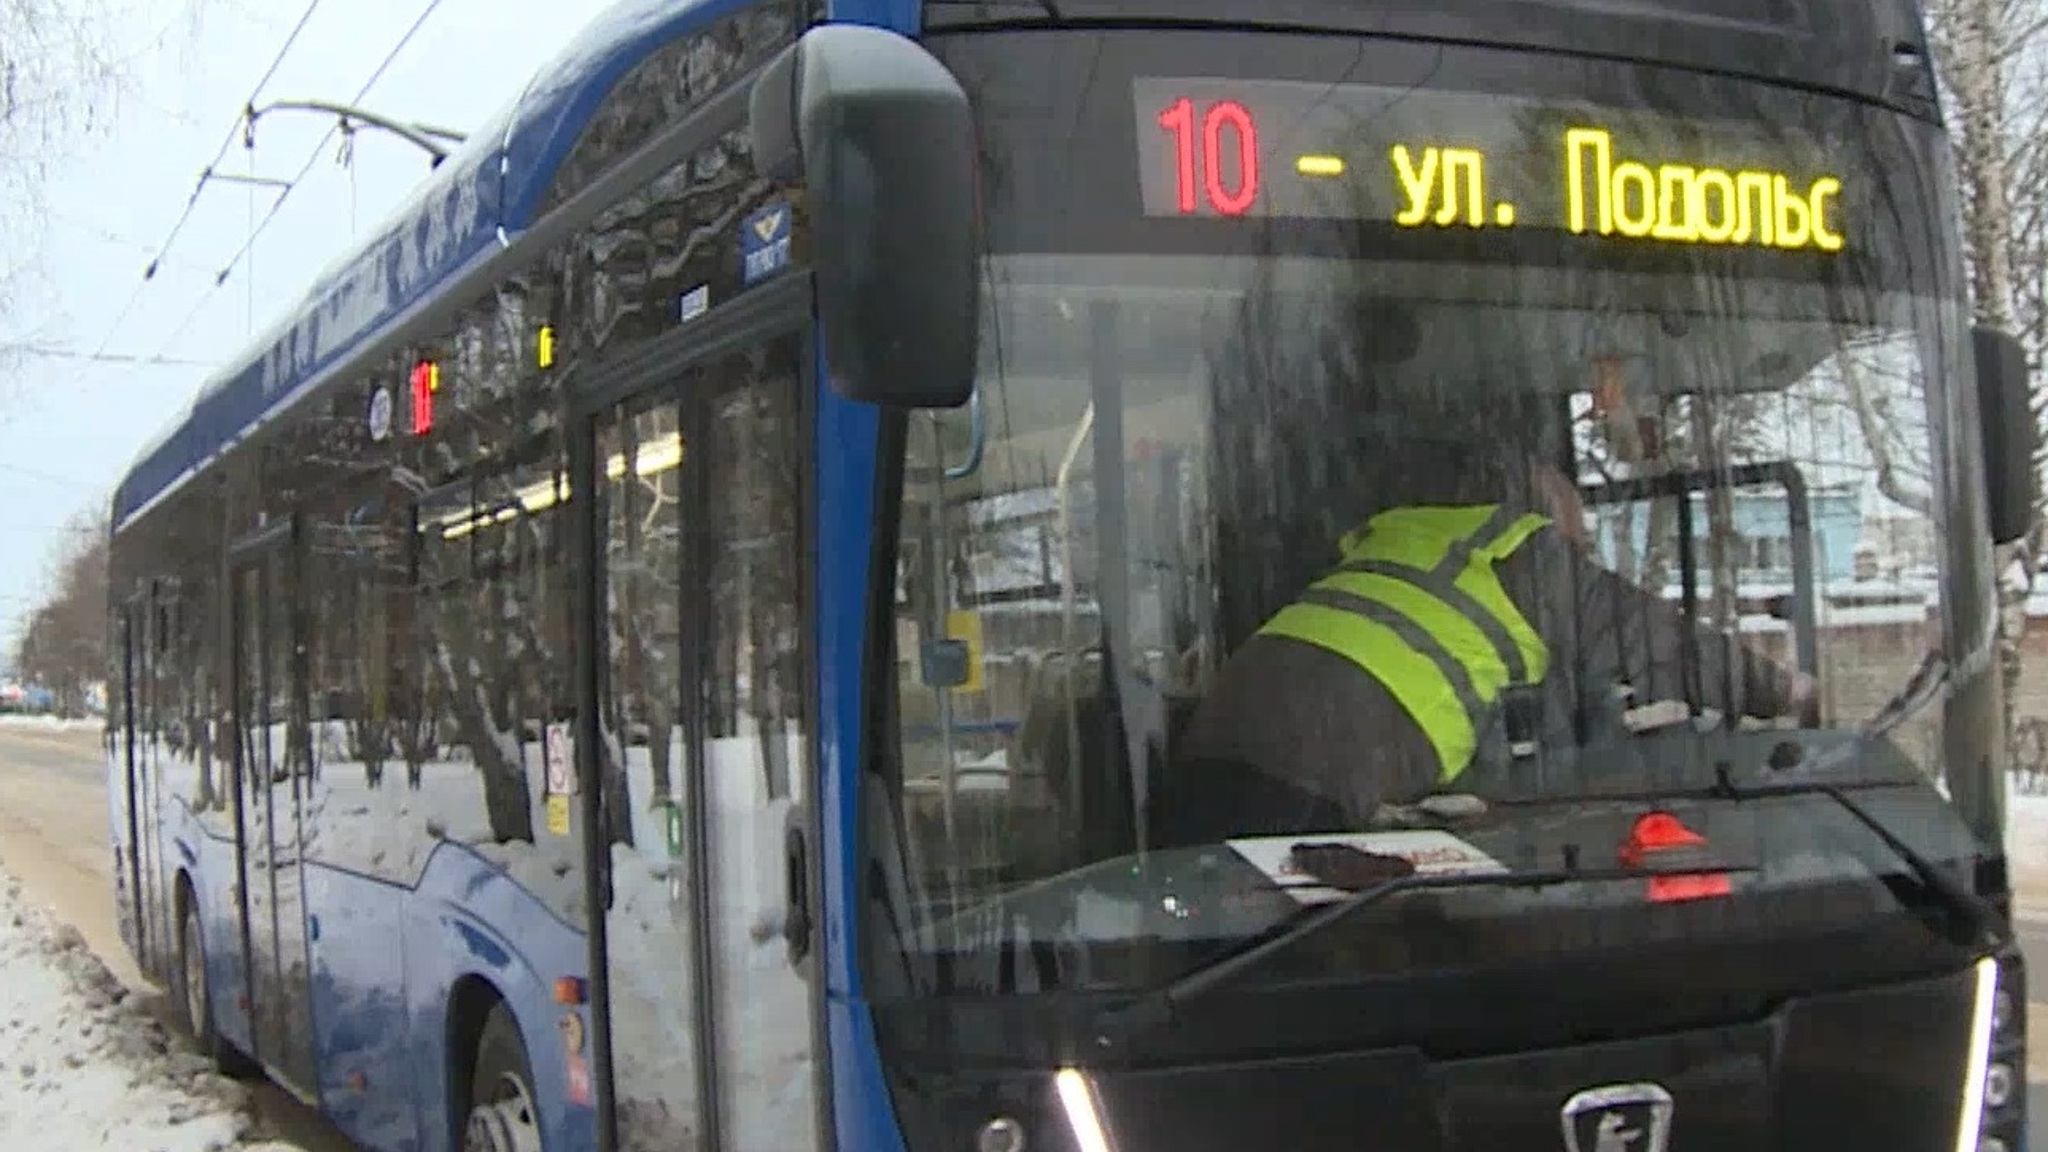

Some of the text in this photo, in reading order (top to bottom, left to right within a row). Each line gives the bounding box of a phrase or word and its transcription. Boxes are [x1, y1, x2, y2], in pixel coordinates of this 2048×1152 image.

[1157, 97, 1259, 217] 10
[1392, 144, 1516, 228] ул.
[1566, 128, 1845, 251] Подольс
